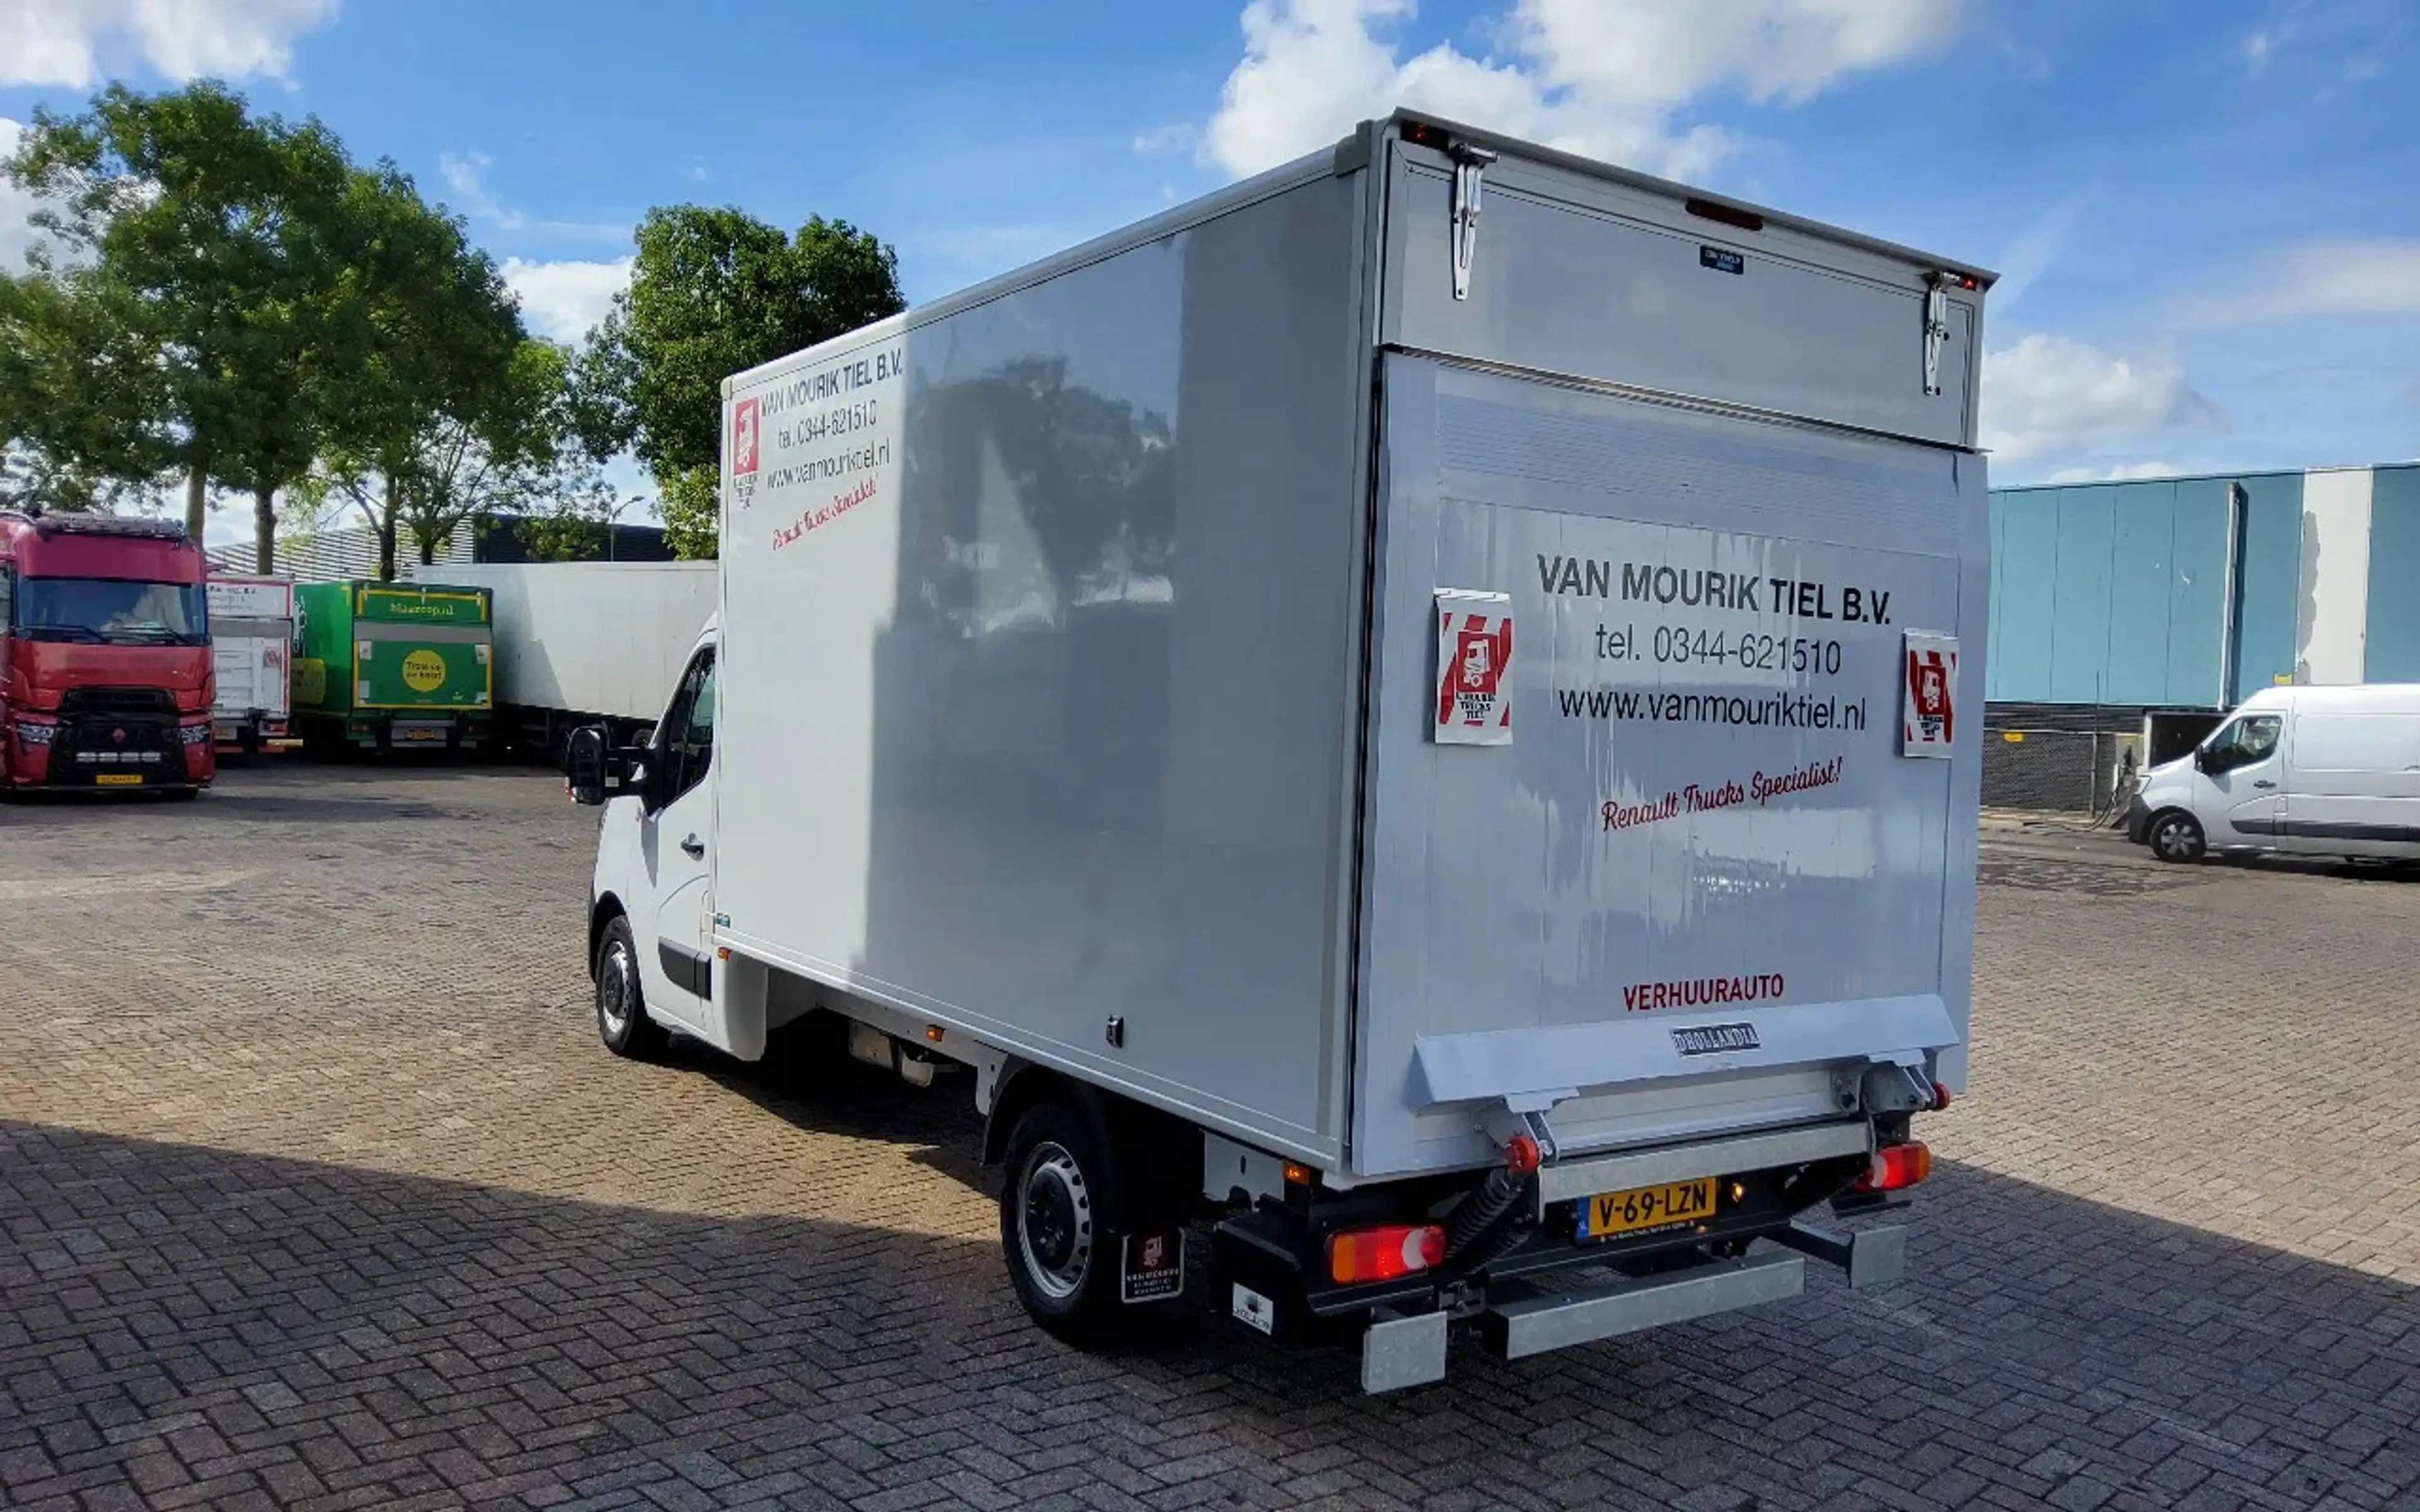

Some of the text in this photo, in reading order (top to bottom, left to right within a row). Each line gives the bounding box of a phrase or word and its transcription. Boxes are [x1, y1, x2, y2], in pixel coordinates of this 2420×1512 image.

[787, 369, 839, 409] MOURIK
[843, 359, 872, 391] TIEL
[877, 348, 902, 381] B.V.
[1537, 554, 1891, 624] VAN MOURIK TIEL B.V.
[1596, 624, 1841, 675] tel. 0344-621510
[1559, 690, 1865, 730] www.vanmouriktiel.nl
[1601, 756, 1843, 832] Renault Trucks Specialist!
[1623, 973, 1784, 1012] VERHUURAUTO
[1599, 1182, 1707, 1228] V-69-LZN
